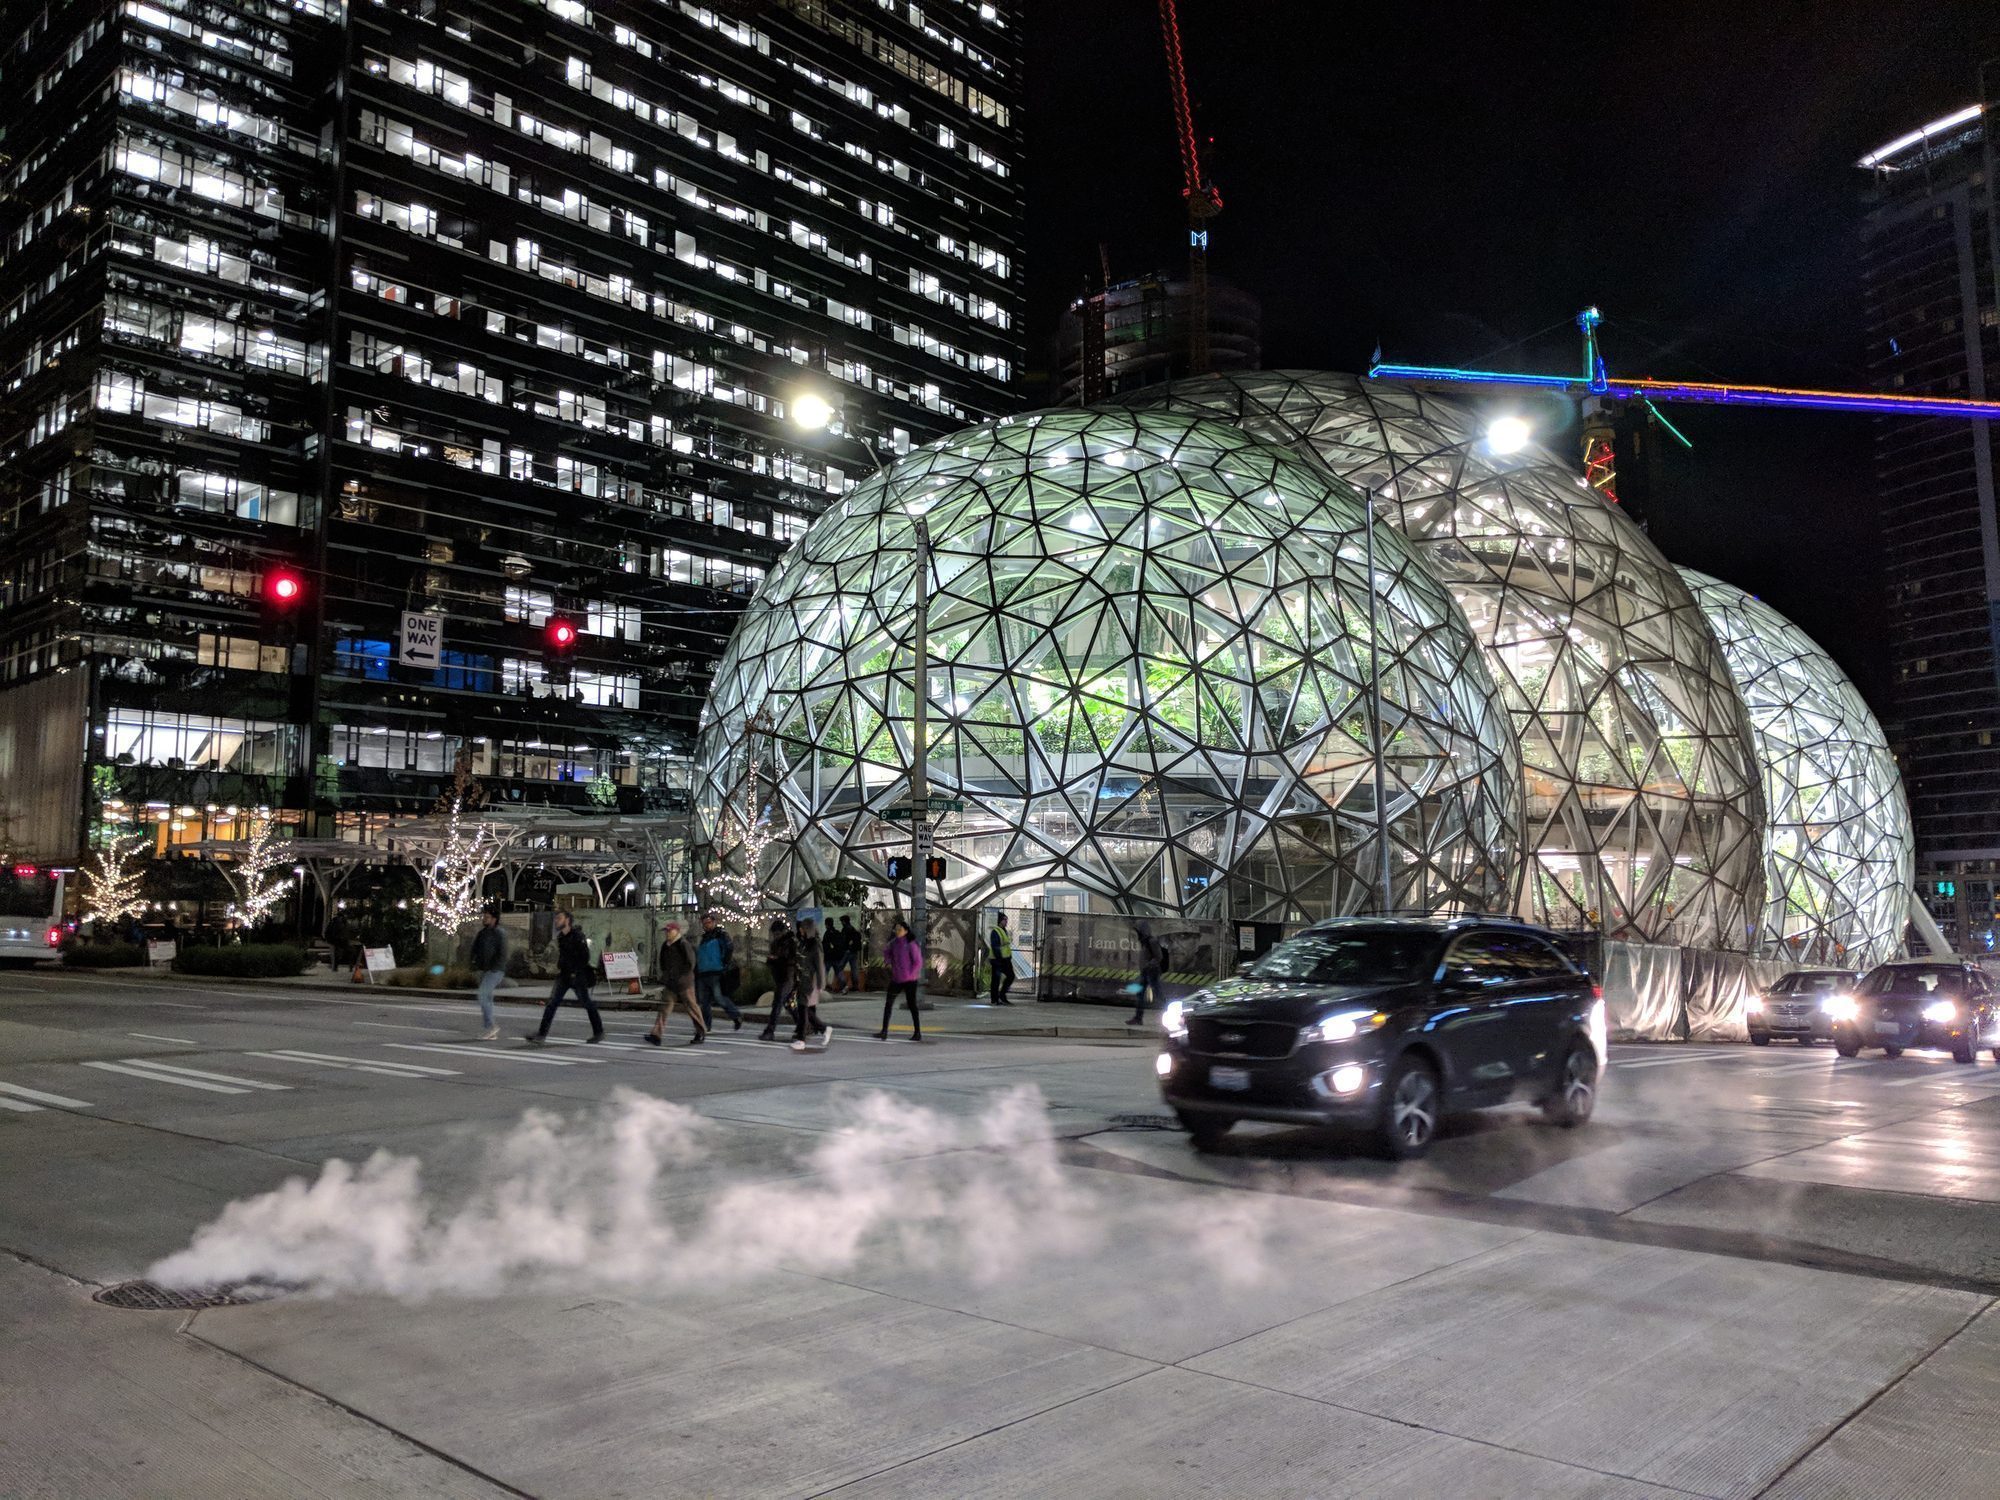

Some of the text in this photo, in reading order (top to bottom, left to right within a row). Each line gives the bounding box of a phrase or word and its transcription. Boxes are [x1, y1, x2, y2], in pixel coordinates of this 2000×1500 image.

[1191, 230, 1207, 246] M
[407, 617, 437, 632] ONE
[407, 631, 437, 646] WAY
[918, 824, 932, 833] ONE
[918, 833, 932, 842] WAY
[1094, 938, 1116, 950] am
